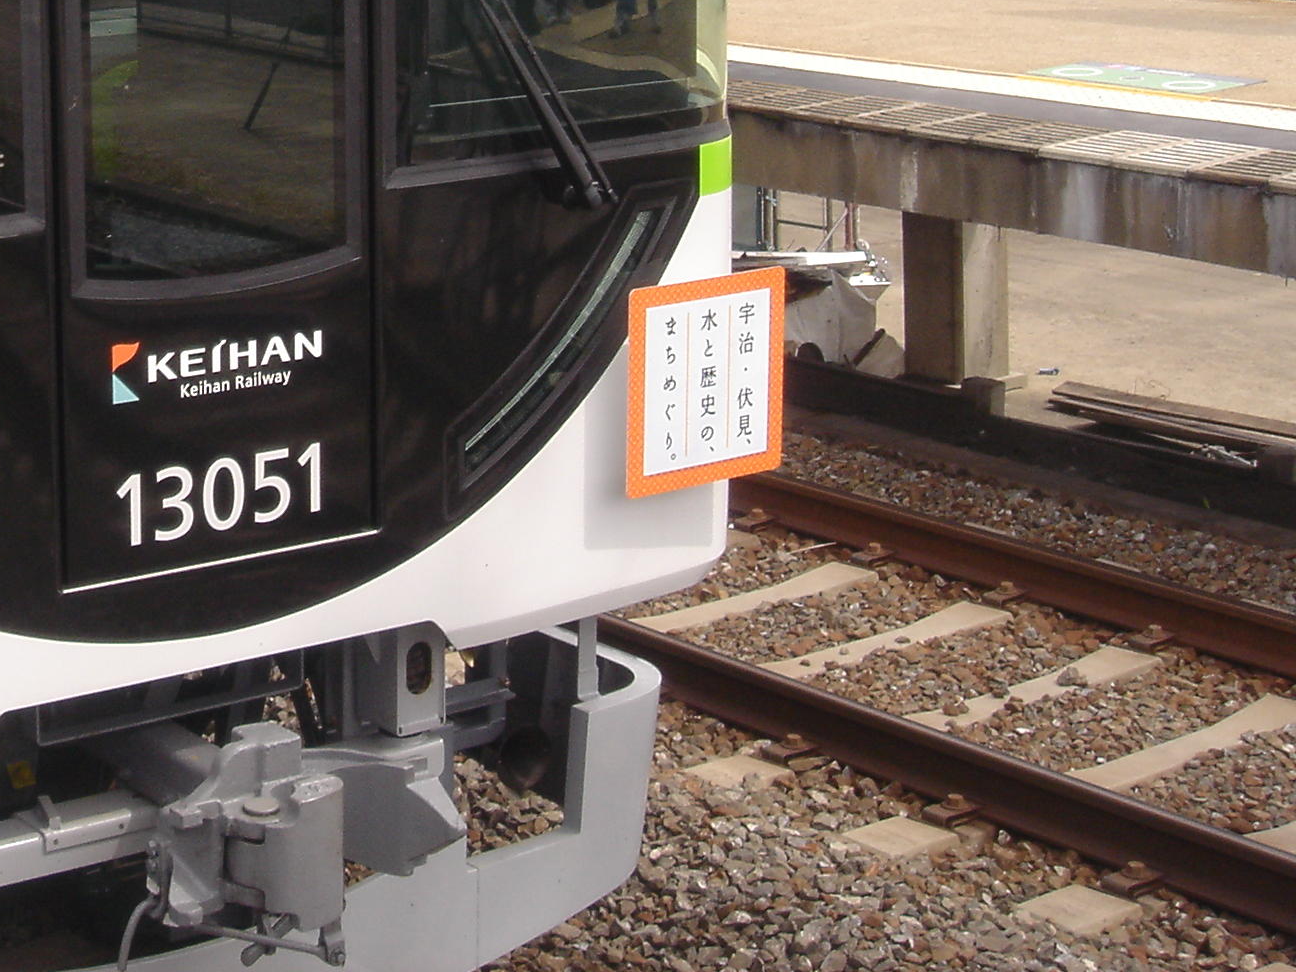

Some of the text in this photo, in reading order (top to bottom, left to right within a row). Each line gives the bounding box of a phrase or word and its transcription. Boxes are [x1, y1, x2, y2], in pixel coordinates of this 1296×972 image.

[147, 330, 323, 384] KEIHAN
[180, 369, 292, 399] Keihan Railway
[662, 316, 678, 461] まちめぐり。
[700, 309, 718, 452] 水と歴史の、
[736, 302, 755, 445] 宇治・伏見、
[116, 442, 321, 547] 13051
